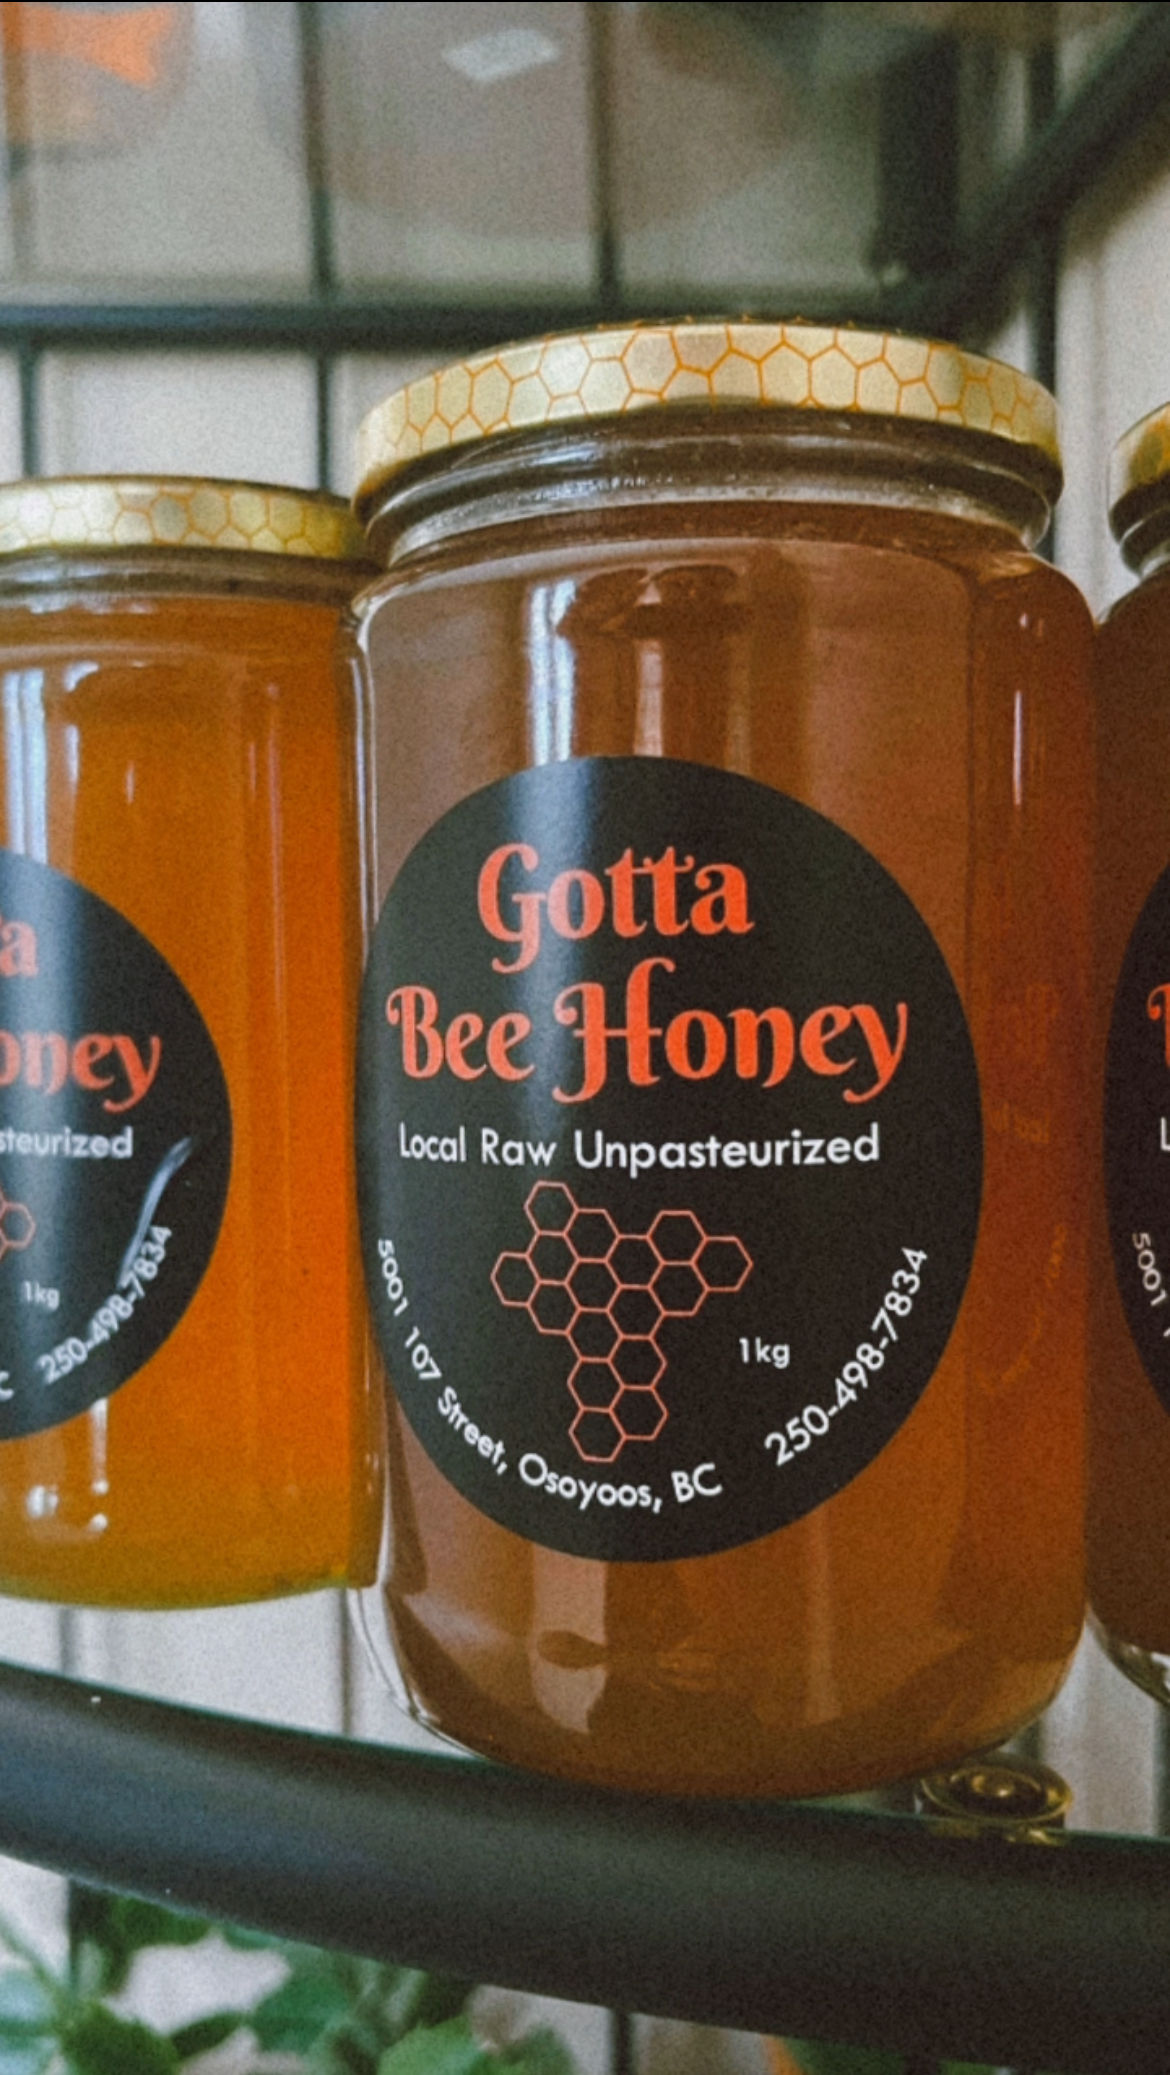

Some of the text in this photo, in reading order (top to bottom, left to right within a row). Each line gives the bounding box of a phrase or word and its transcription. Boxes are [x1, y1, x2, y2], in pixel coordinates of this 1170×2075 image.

[477, 842, 755, 974] Gotta
[386, 957, 908, 1104] Bee Honey
[400, 1122, 880, 1178] Local Raw Unpasteurized
[37, 1225, 173, 1385] 250-498-7834
[1132, 1232, 1168, 1306] 5001
[378, 1239, 723, 1514] 5001 107 Street, Osoyoos, BC
[739, 1336, 791, 1369] 1kg
[764, 1247, 928, 1467] 250-498-7834
